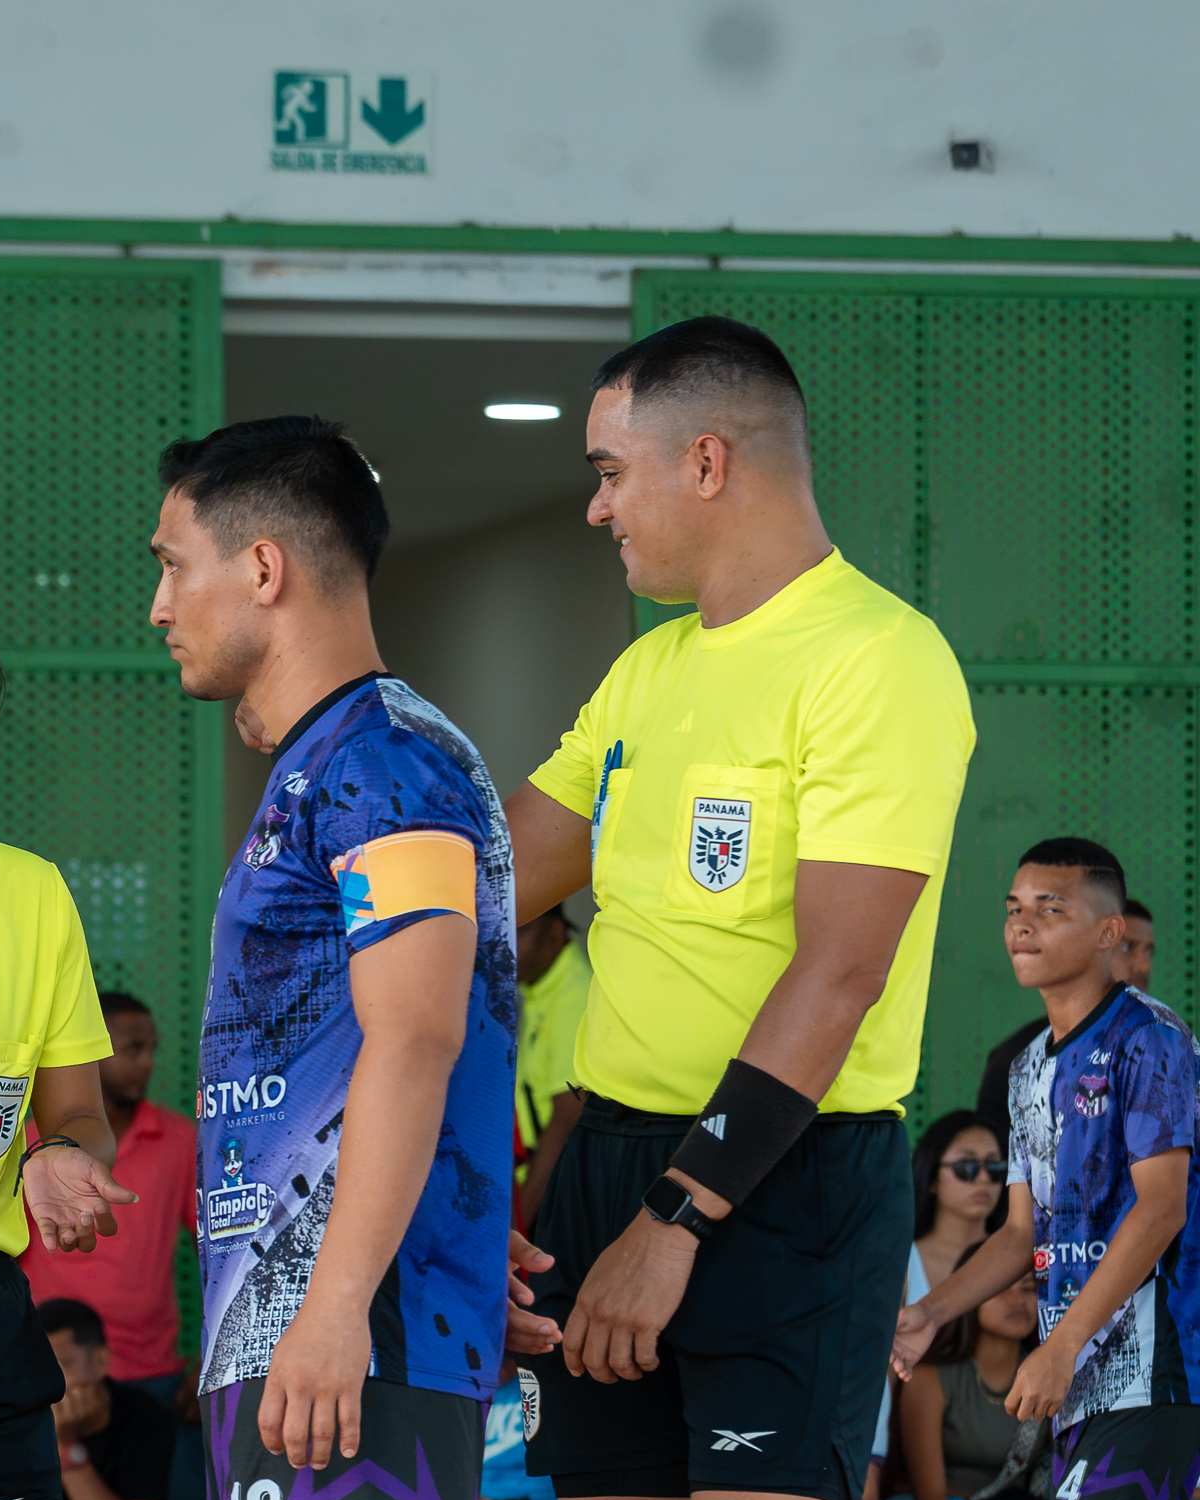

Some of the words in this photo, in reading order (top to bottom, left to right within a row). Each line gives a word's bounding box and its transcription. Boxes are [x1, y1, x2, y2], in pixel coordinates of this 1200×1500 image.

[226, 1111, 286, 1128] MARKETING
[210, 1190, 257, 1218] Limpio
[211, 1215, 231, 1230] Total
